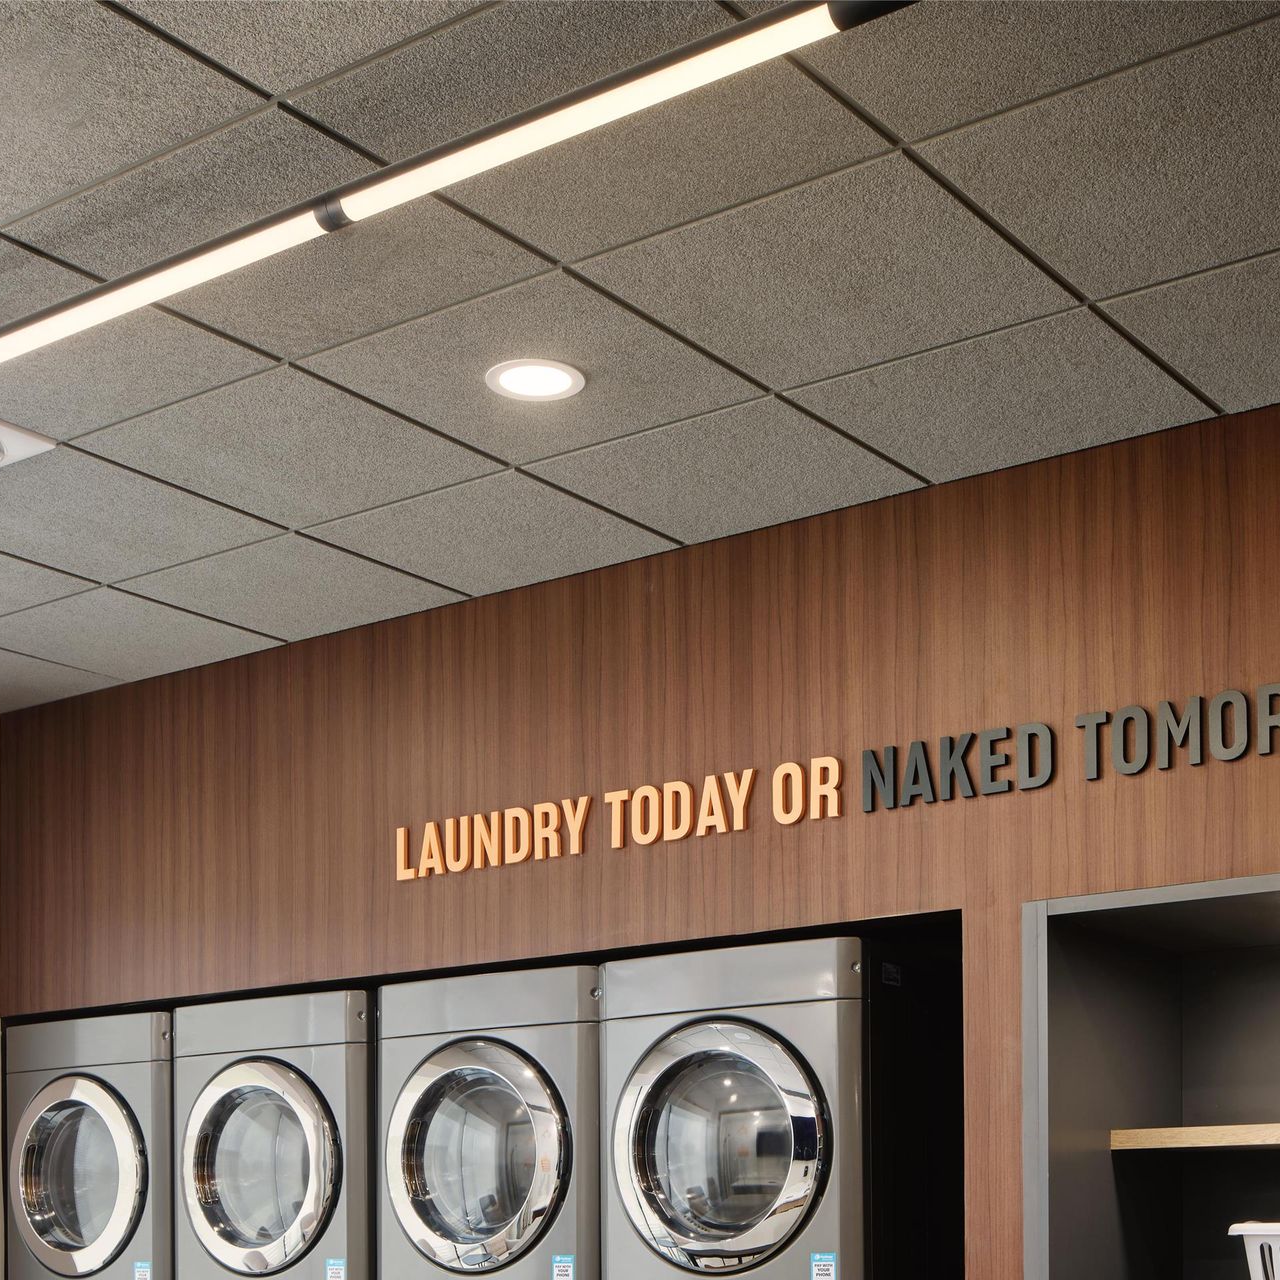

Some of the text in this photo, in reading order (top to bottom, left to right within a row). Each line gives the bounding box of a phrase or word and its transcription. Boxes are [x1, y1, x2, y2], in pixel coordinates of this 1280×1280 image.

[396, 795, 592, 882] LAUNDRY
[604, 768, 756, 850] TODAY
[772, 755, 842, 826] OR
[861, 721, 1053, 813] NAKED
